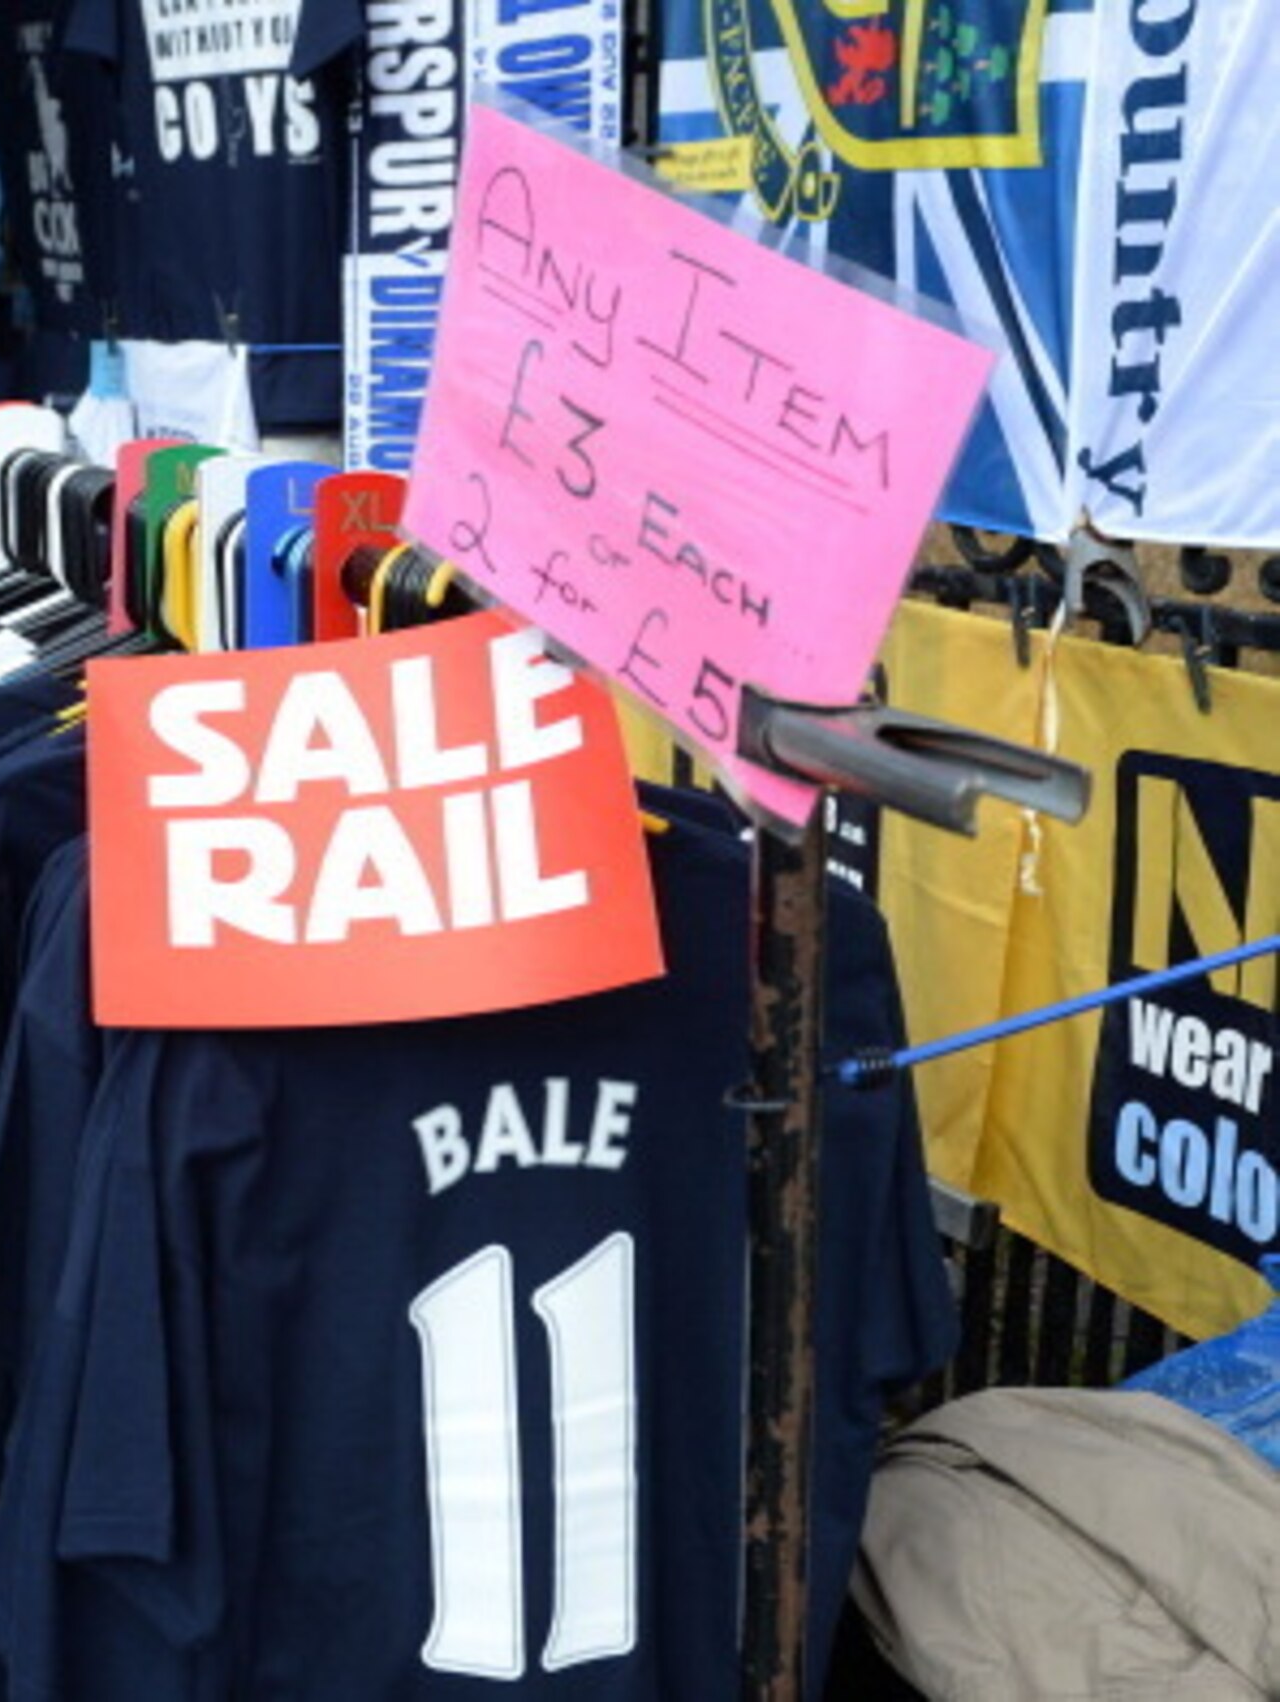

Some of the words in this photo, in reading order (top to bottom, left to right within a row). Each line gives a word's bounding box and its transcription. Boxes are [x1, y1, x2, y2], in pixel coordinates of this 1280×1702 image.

[1076, 0, 1198, 518] ountry
[634, 248, 891, 491] ITEM
[288, 477, 317, 515] L
[338, 490, 398, 532] XL
[636, 490, 774, 629] EACH
[530, 549, 600, 614] for
[147, 628, 583, 808] SALE
[165, 779, 590, 948] RAIL
[1128, 996, 1273, 1116] wear
[412, 1076, 637, 1196] BALE
[409, 1230, 637, 1680] 11
